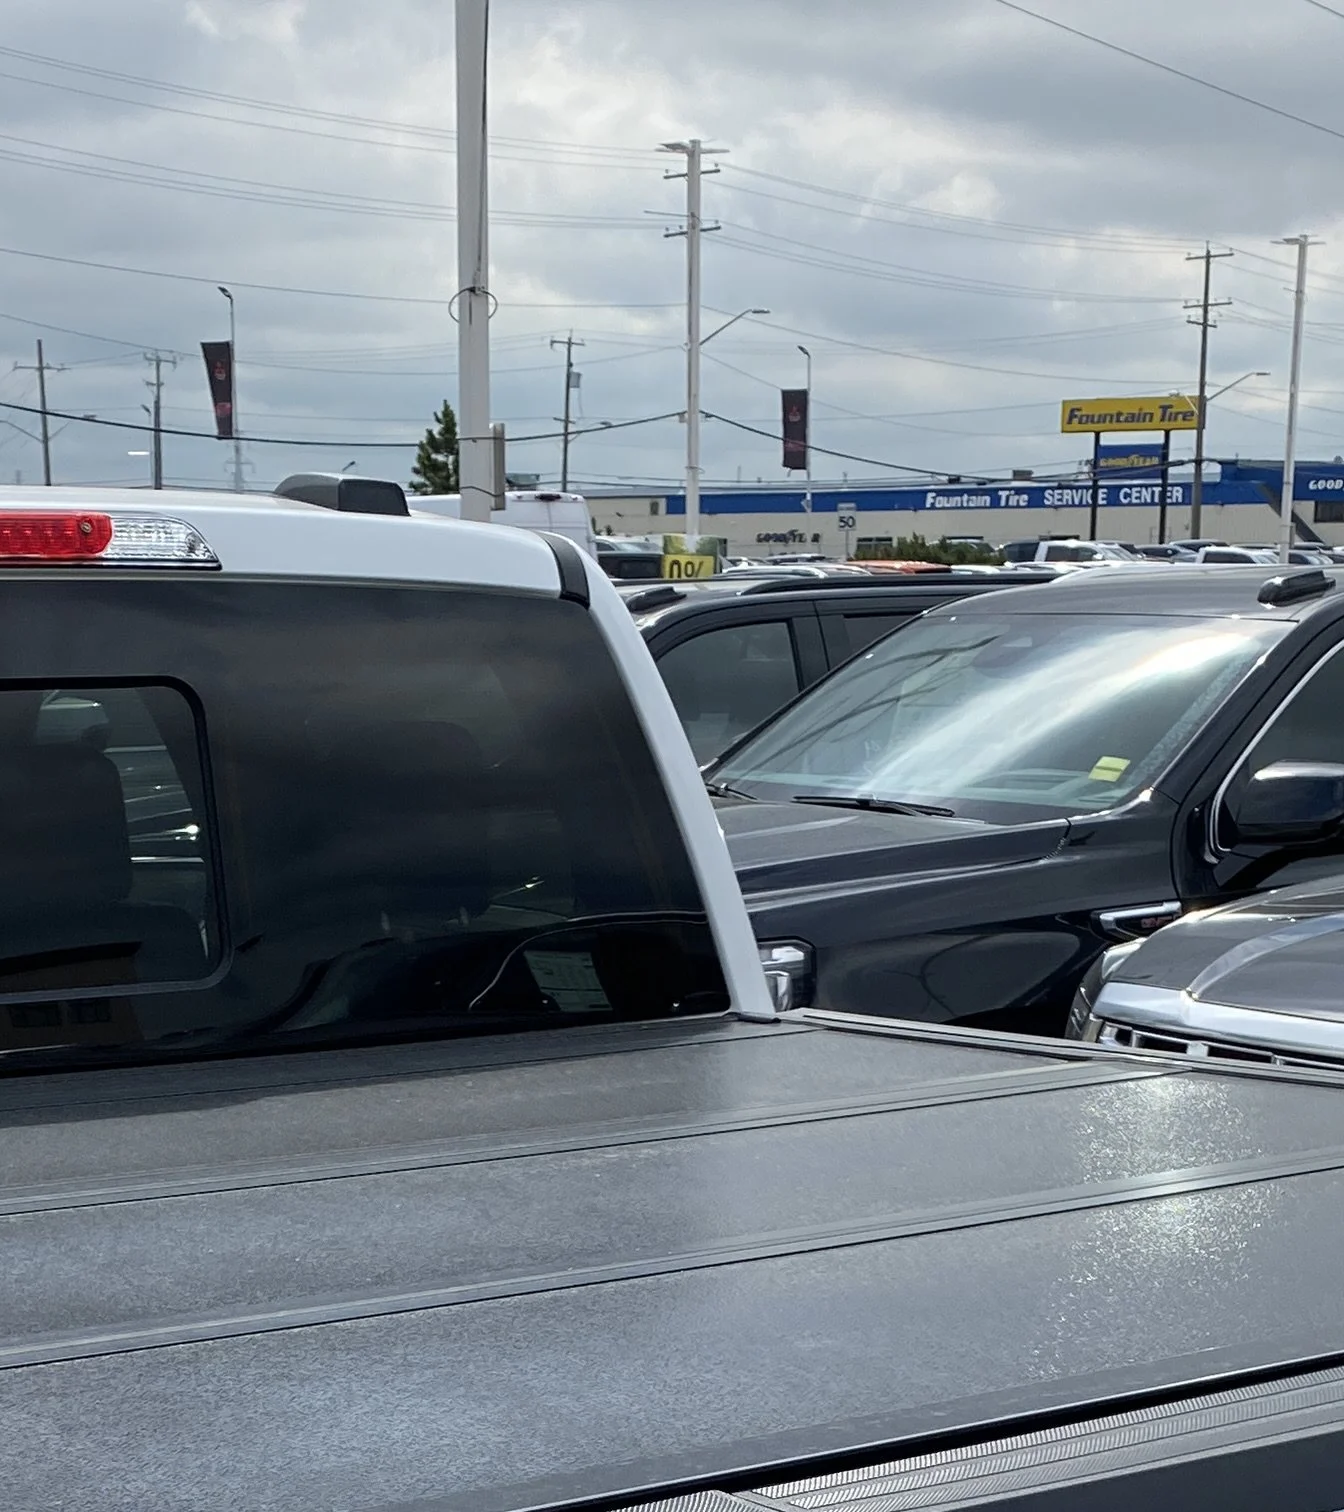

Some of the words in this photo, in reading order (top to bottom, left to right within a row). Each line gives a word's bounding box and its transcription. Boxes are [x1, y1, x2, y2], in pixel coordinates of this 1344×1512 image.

[1066, 407, 1154, 425] Fountain
[1158, 404, 1195, 423] Tire
[925, 492, 991, 508] Fountain
[997, 490, 1029, 507] Tire
[1044, 488, 1108, 505] SERVICE
[1119, 486, 1183, 504] CENTER
[839, 515, 856, 528] 50
[756, 529, 821, 544] GOODYER
